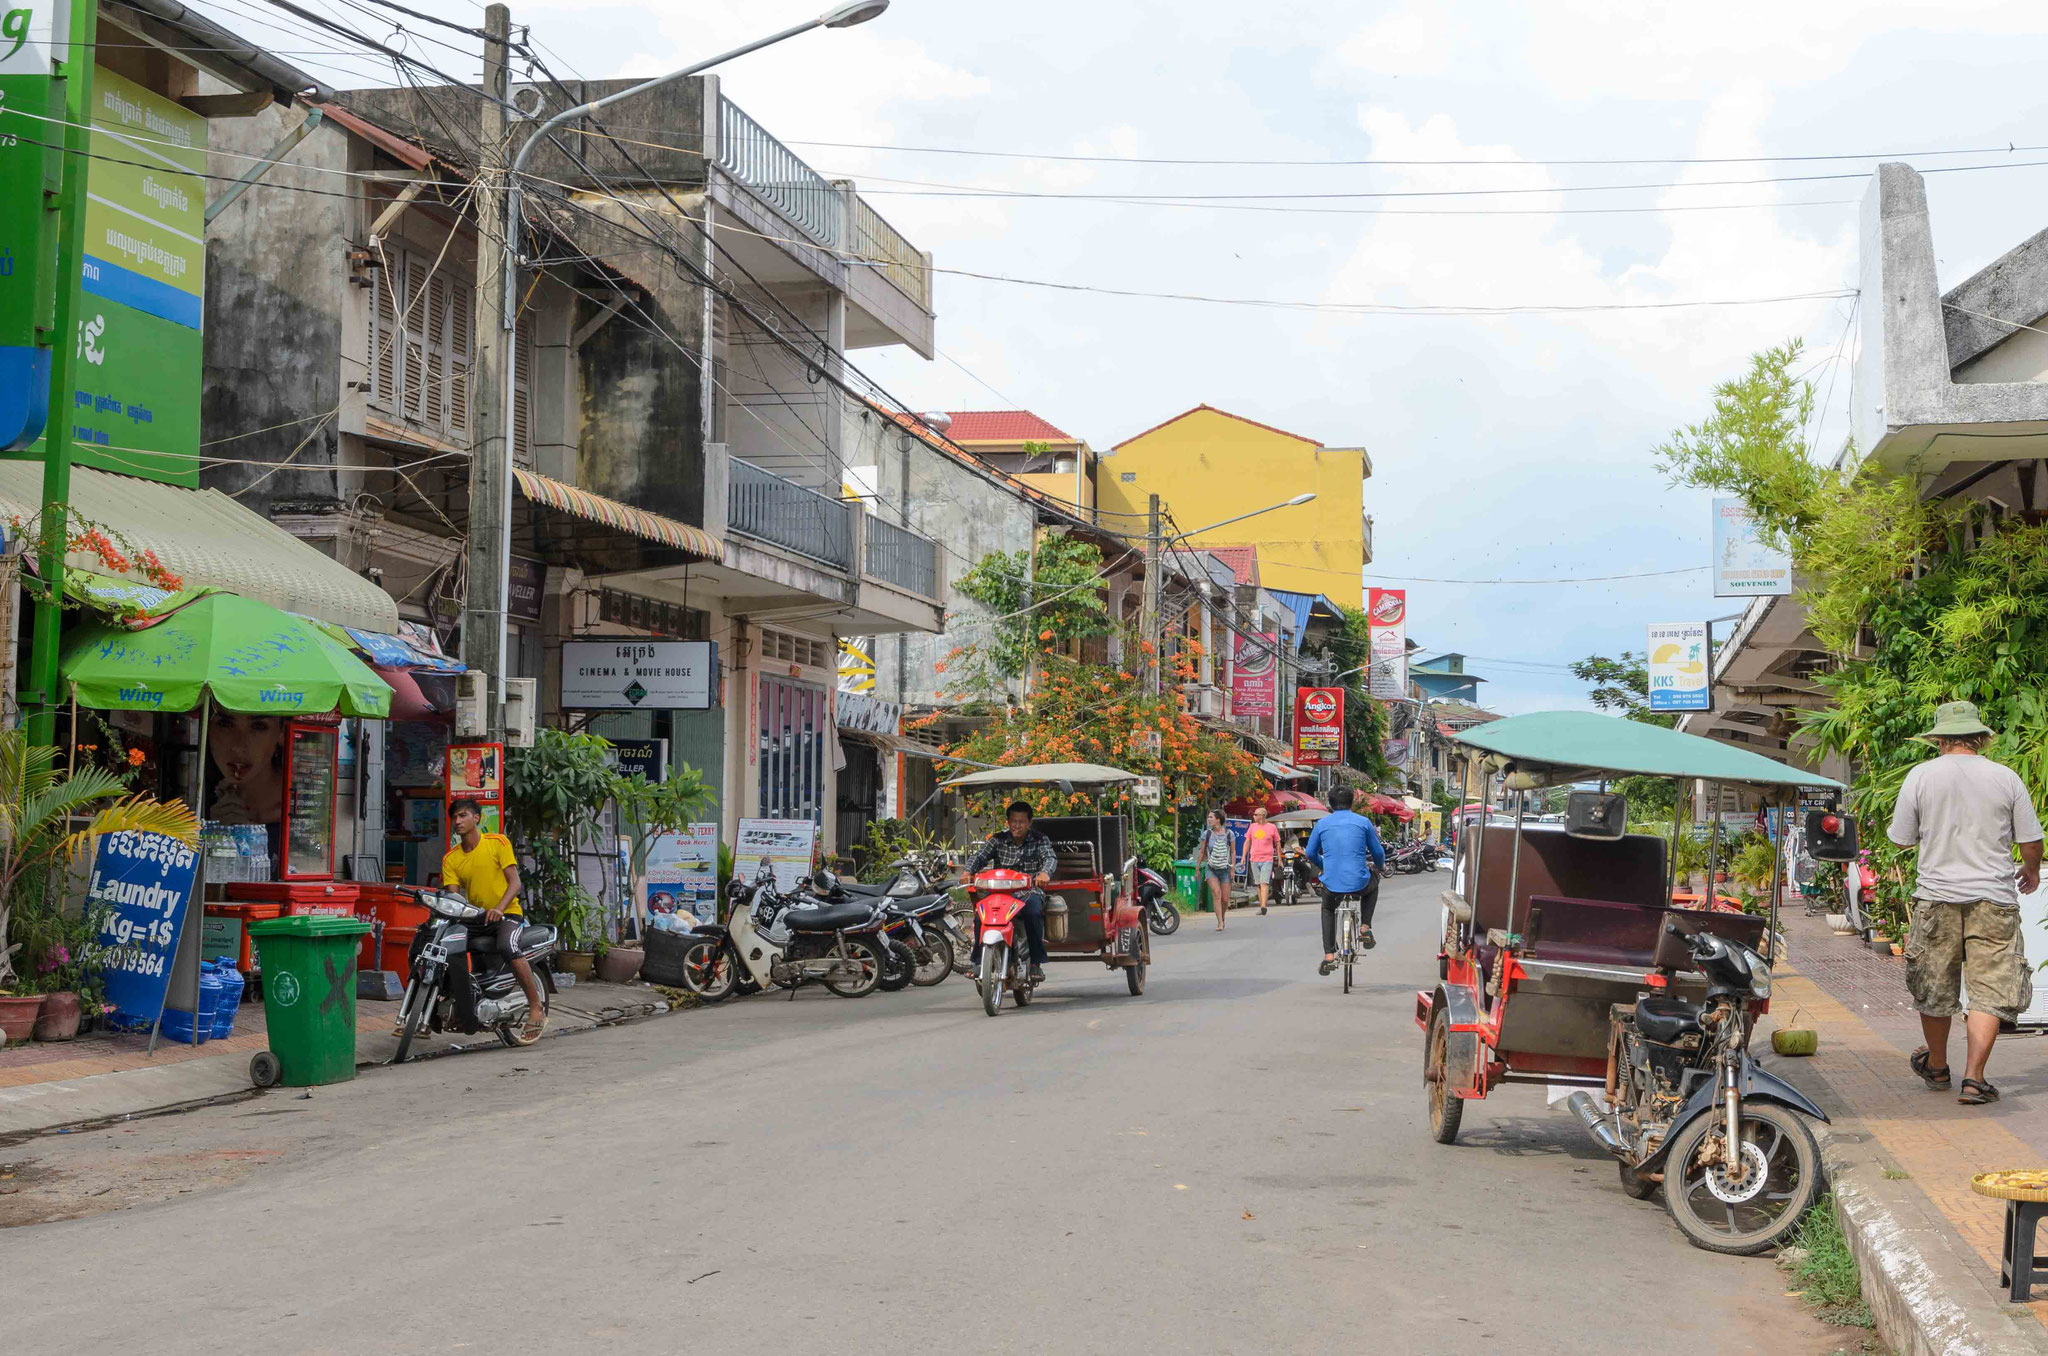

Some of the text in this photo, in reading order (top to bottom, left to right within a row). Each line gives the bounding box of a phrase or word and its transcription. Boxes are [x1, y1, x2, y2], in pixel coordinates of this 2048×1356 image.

[0, 8, 32, 62] g
[509, 584, 535, 600] VELLER
[579, 667, 692, 677] CINEMA & MOVIE HOUSE
[1653, 675, 1703, 687] KKS Travel
[119, 688, 164, 708] Wing
[259, 689, 304, 707] Wing
[1304, 702, 1336, 712] Angkor
[619, 764, 645, 772] ELLER
[89, 870, 182, 919] Laundry
